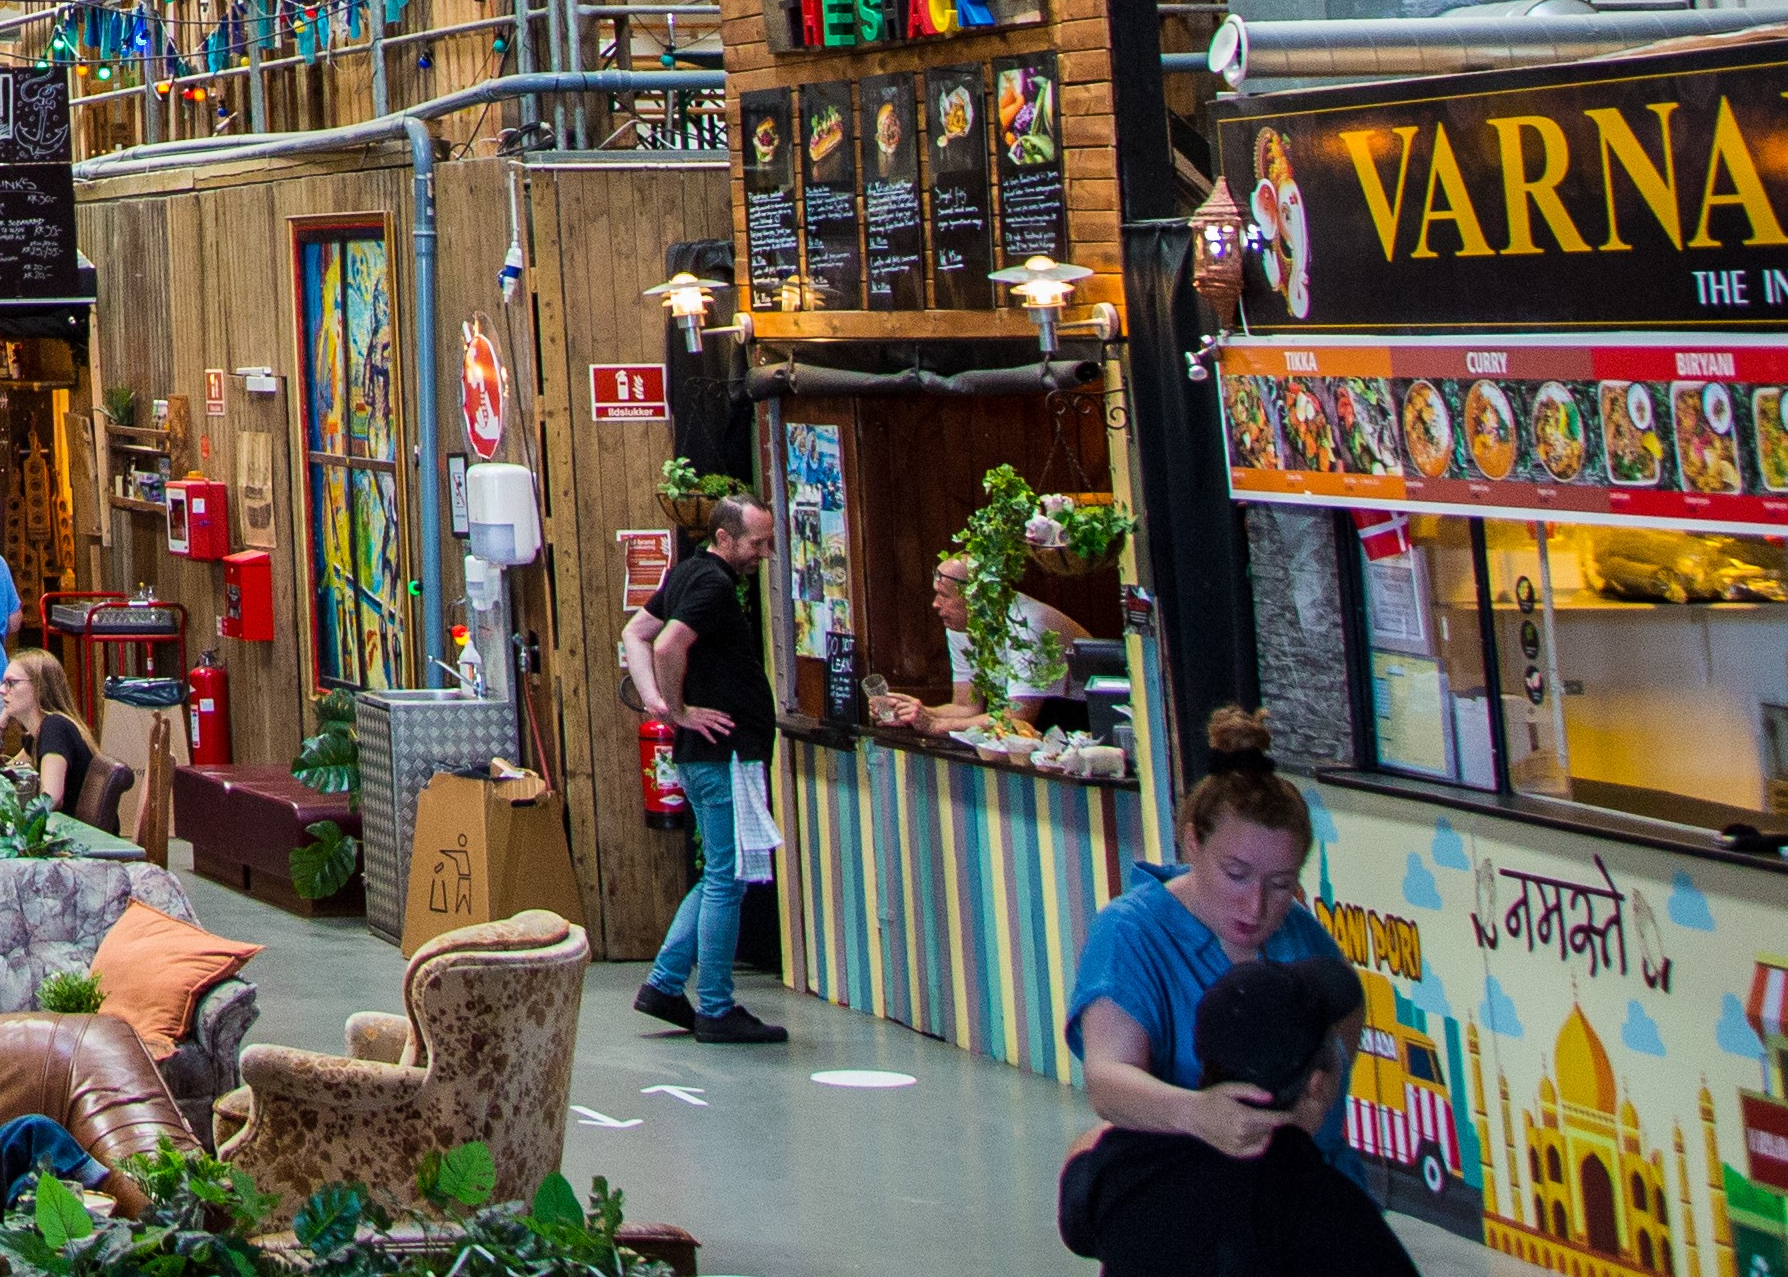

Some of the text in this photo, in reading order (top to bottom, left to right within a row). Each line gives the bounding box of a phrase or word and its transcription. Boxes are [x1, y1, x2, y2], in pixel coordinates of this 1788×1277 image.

[1339, 96, 1788, 263] VARNA
[1691, 270, 1749, 305] THE
[1284, 351, 1318, 373] TIKKA
[1465, 352, 1507, 374] CURRY
[1674, 352, 1735, 377] BIRYANI
[1499, 853, 1624, 977] नमस्ते
[1367, 909, 1422, 982] PURI
